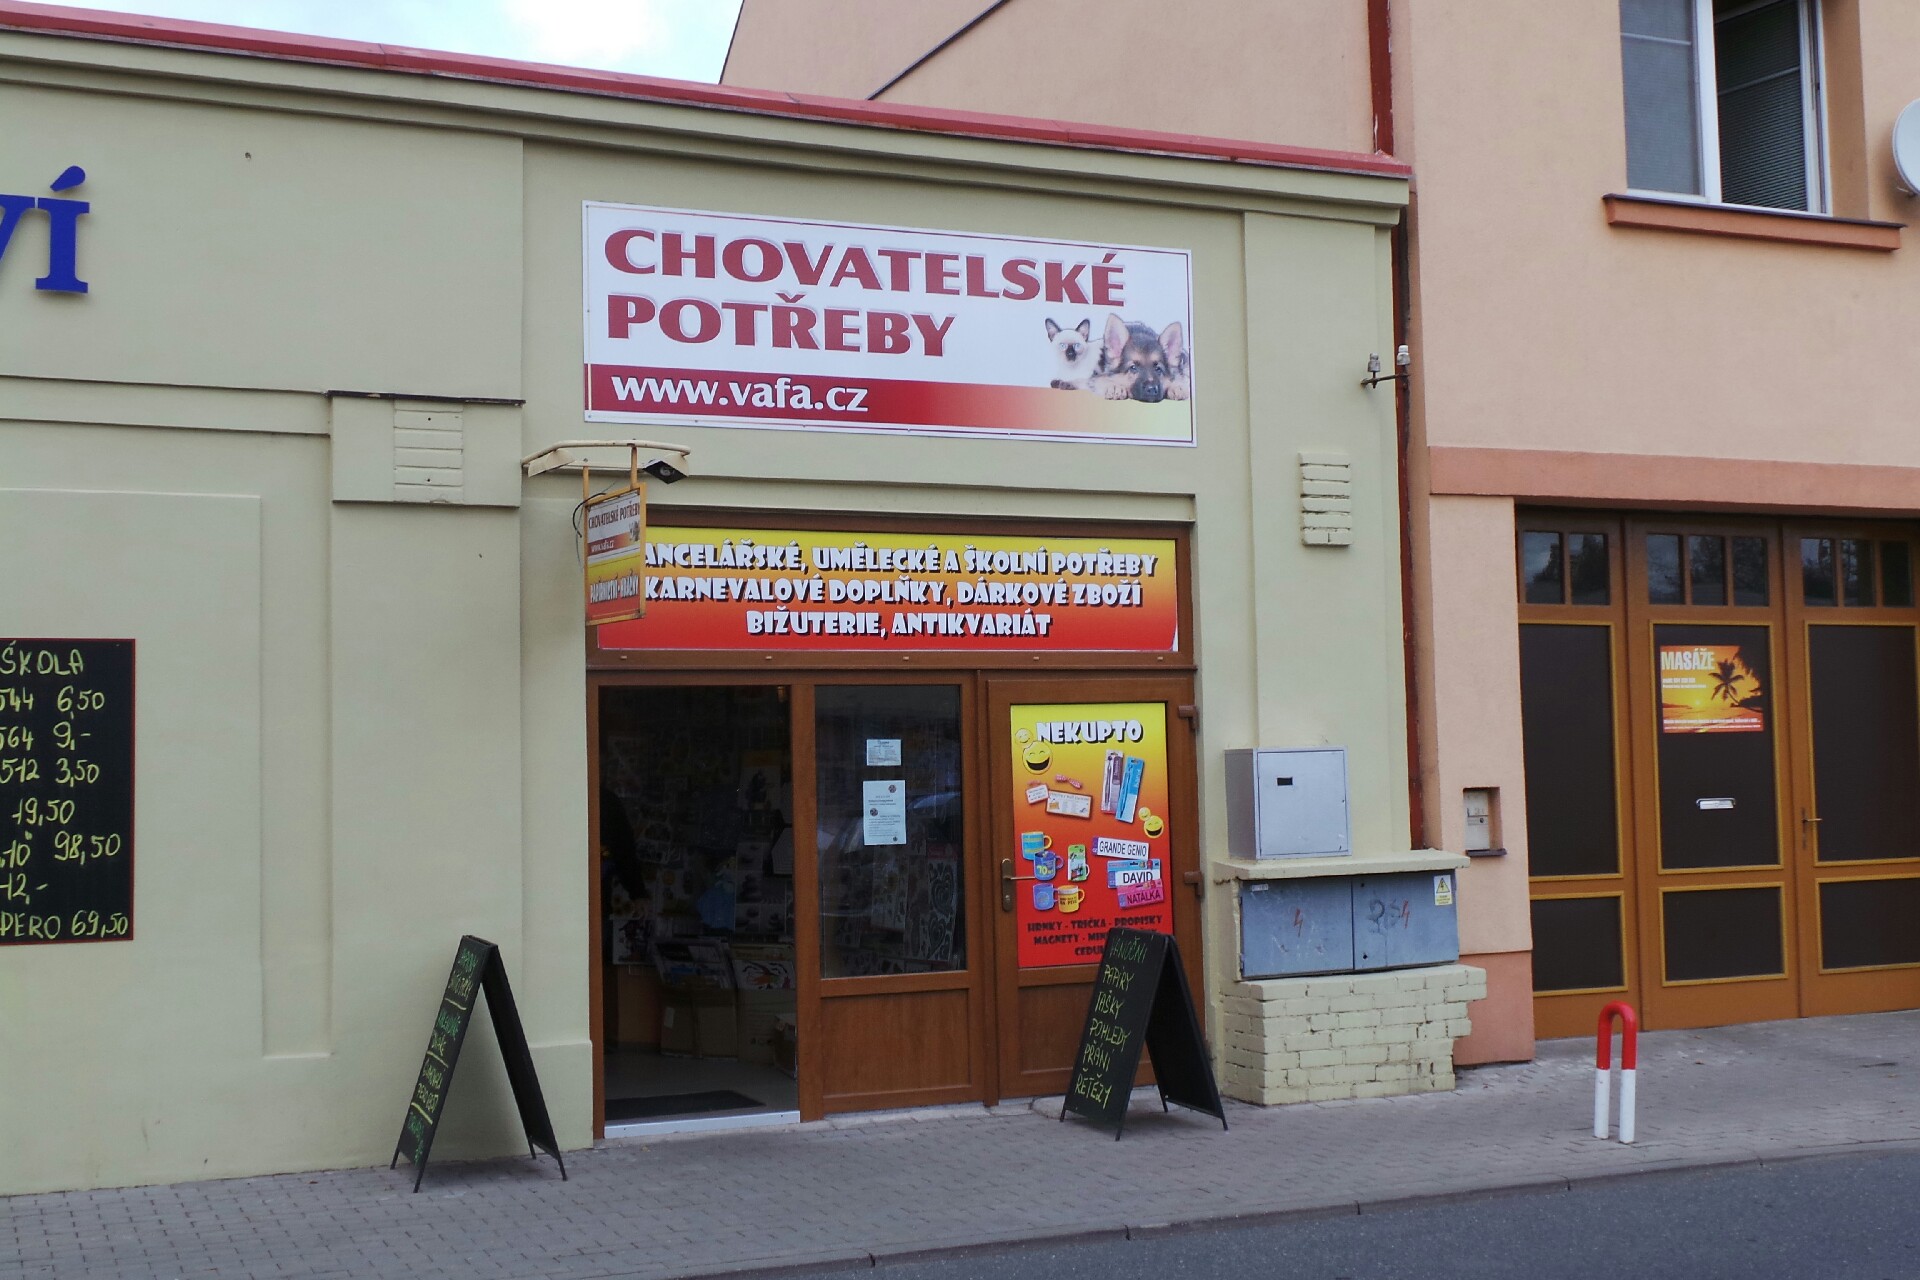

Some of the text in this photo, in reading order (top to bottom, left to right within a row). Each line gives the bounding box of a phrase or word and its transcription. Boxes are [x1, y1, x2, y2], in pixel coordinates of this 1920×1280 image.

[603, 227, 1126, 307] CHOVATELSKÉ
[606, 292, 956, 358] POTŘEBY
[611, 375, 869, 413] www.vafa.cz
[645, 538, 1158, 576] ANCELÁŘSKÉ, UMĚLECKÉ A ŠKOLNÍ POTŘEBY
[645, 572, 1141, 606] KARNEVALOVÉ DOPLŇKY, DÁRKOVÉ ZBOŽÍ
[746, 605, 1051, 638] BIŽUTERIE, ANTIKVARIÁT
[1661, 647, 1715, 670] MASÁŽE
[1036, 719, 1144, 744] NEKUPTO
[1123, 871, 1154, 884] DAVID
[1034, 934, 1079, 946] MAGNETY
